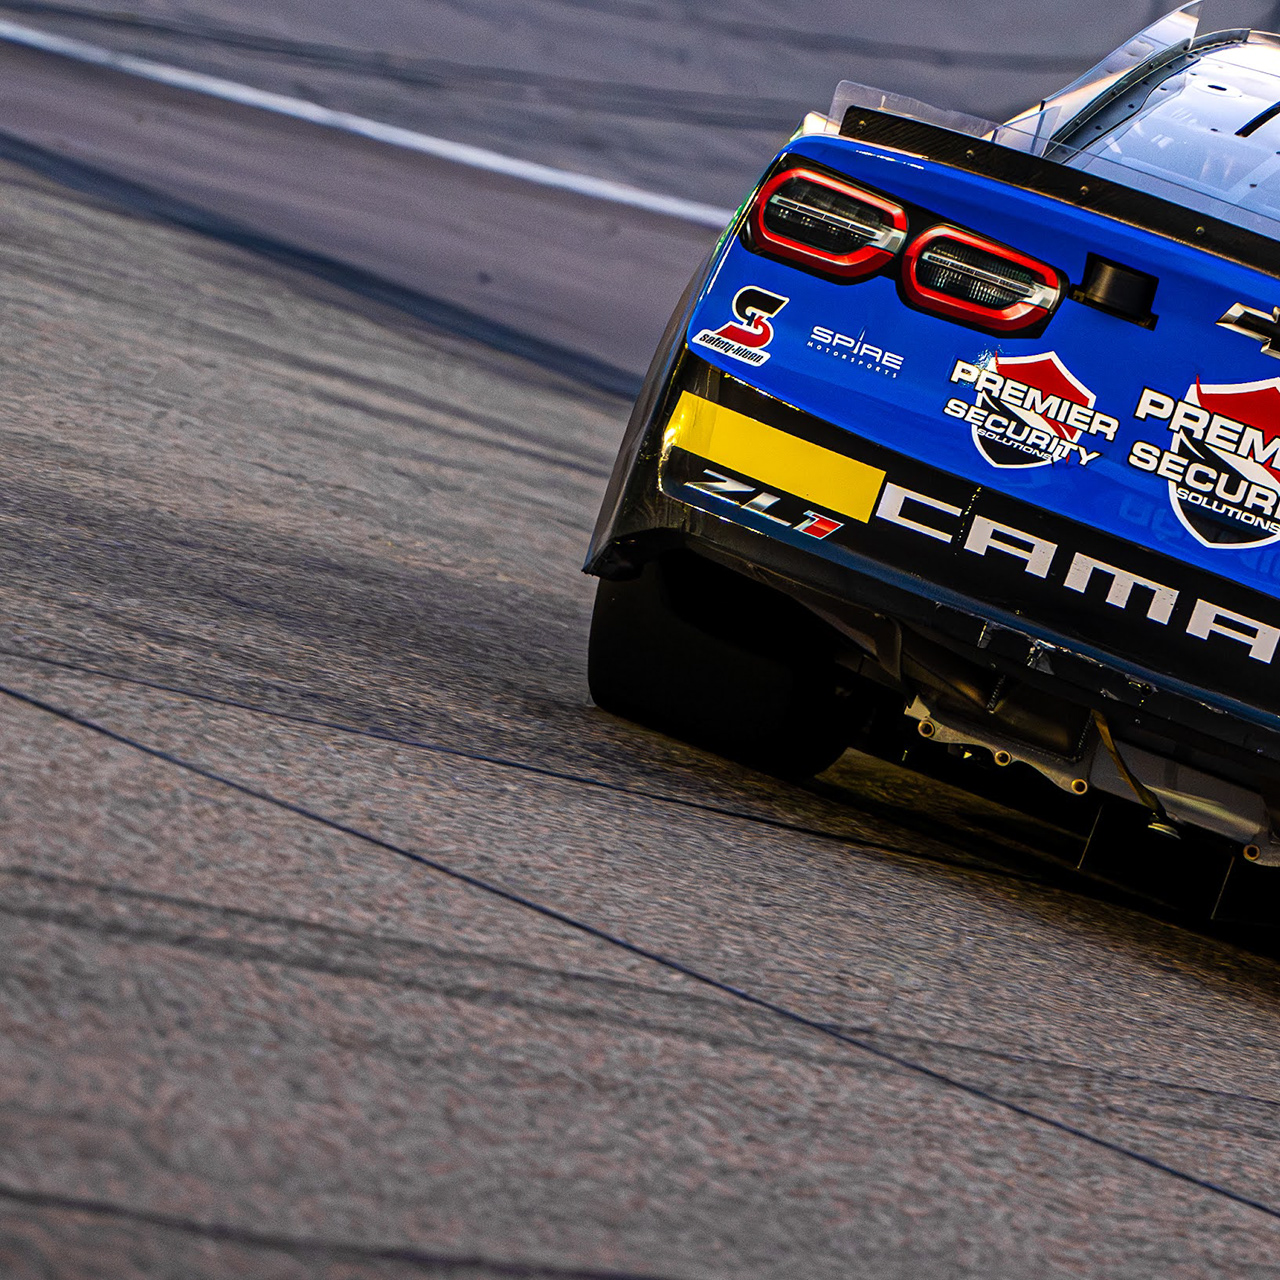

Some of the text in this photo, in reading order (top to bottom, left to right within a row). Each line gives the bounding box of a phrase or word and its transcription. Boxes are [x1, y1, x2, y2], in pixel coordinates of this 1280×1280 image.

[807, 341, 897, 378] MOTORSPORTS
[810, 326, 904, 370] SPIRE
[949, 359, 1120, 442] PREMIER
[943, 398, 1102, 466] SECURITY
[976, 428, 1052, 460] SOLUTIONS
[684, 469, 845, 540] ZL1
